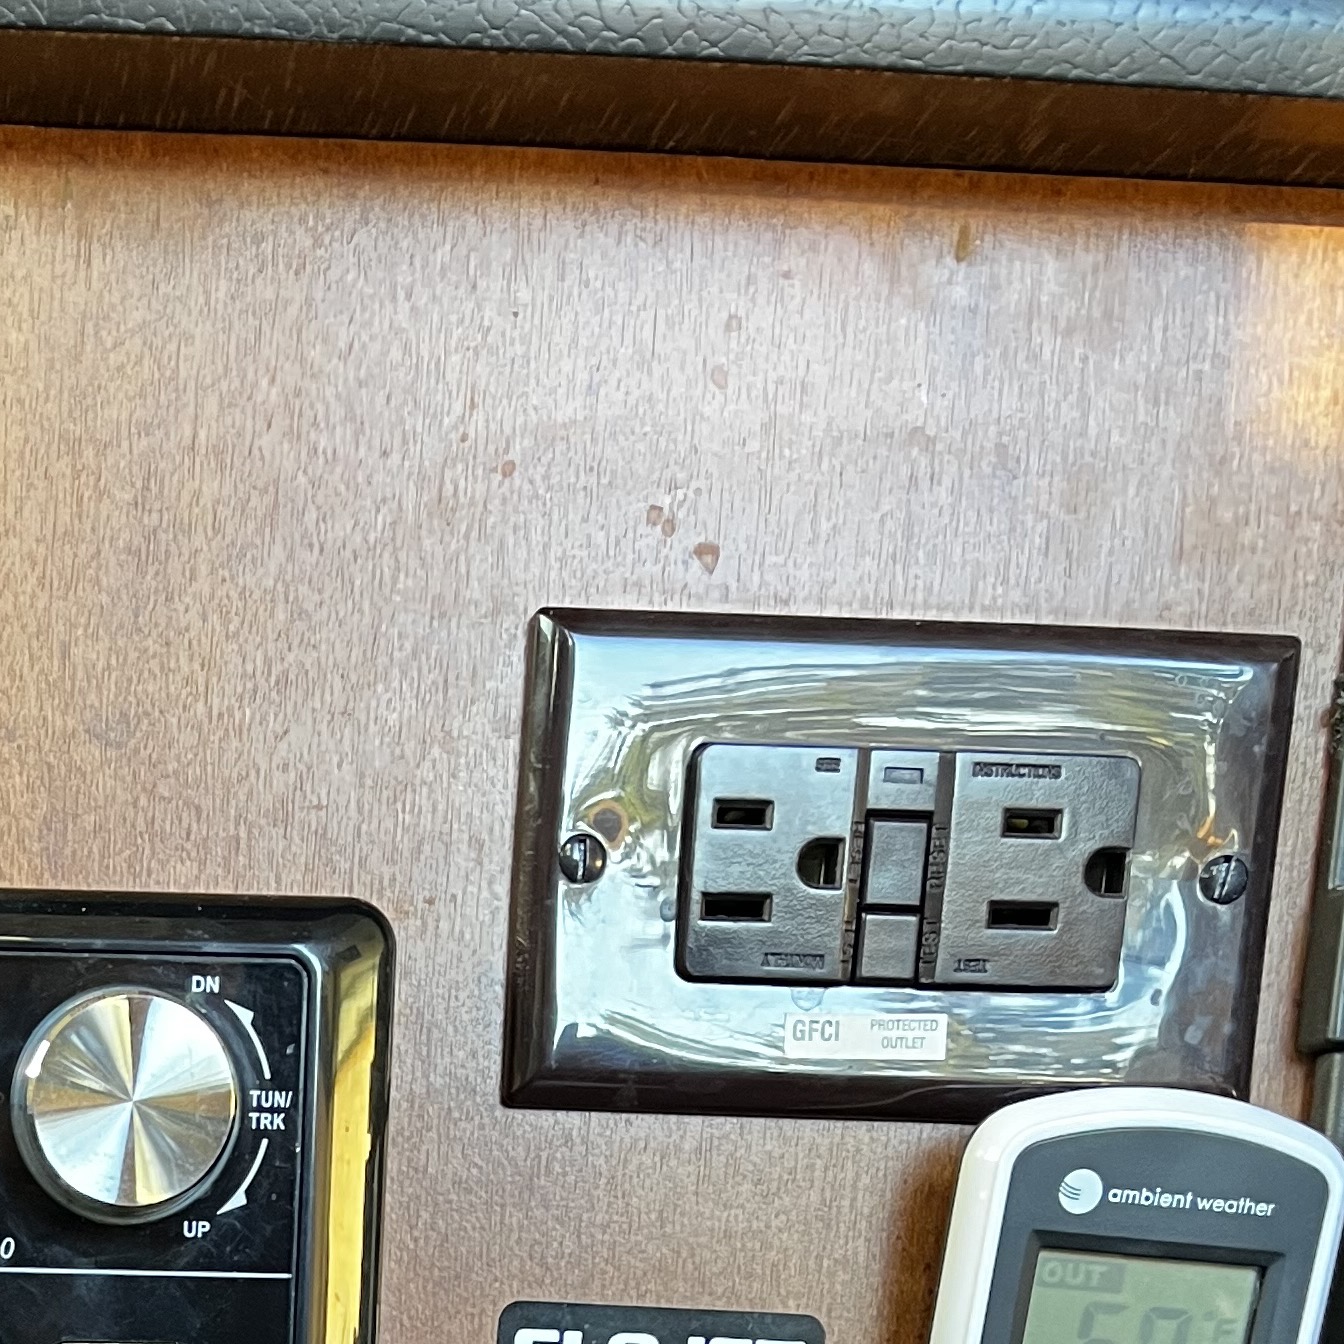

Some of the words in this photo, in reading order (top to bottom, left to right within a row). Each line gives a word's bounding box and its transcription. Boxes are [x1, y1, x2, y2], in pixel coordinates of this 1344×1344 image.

[191, 975, 220, 994] DN
[792, 1019, 840, 1042] GFCI
[870, 1018, 939, 1032] PROTECTED
[881, 1036, 926, 1050] OUTLET
[249, 1090, 293, 1109] TUN/
[248, 1112, 286, 1131] TRK
[1107, 1187, 1194, 1209] ambient
[1196, 1196, 1276, 1217] weather
[182, 1220, 211, 1238] UP
[1041, 1260, 1109, 1285] OUT
